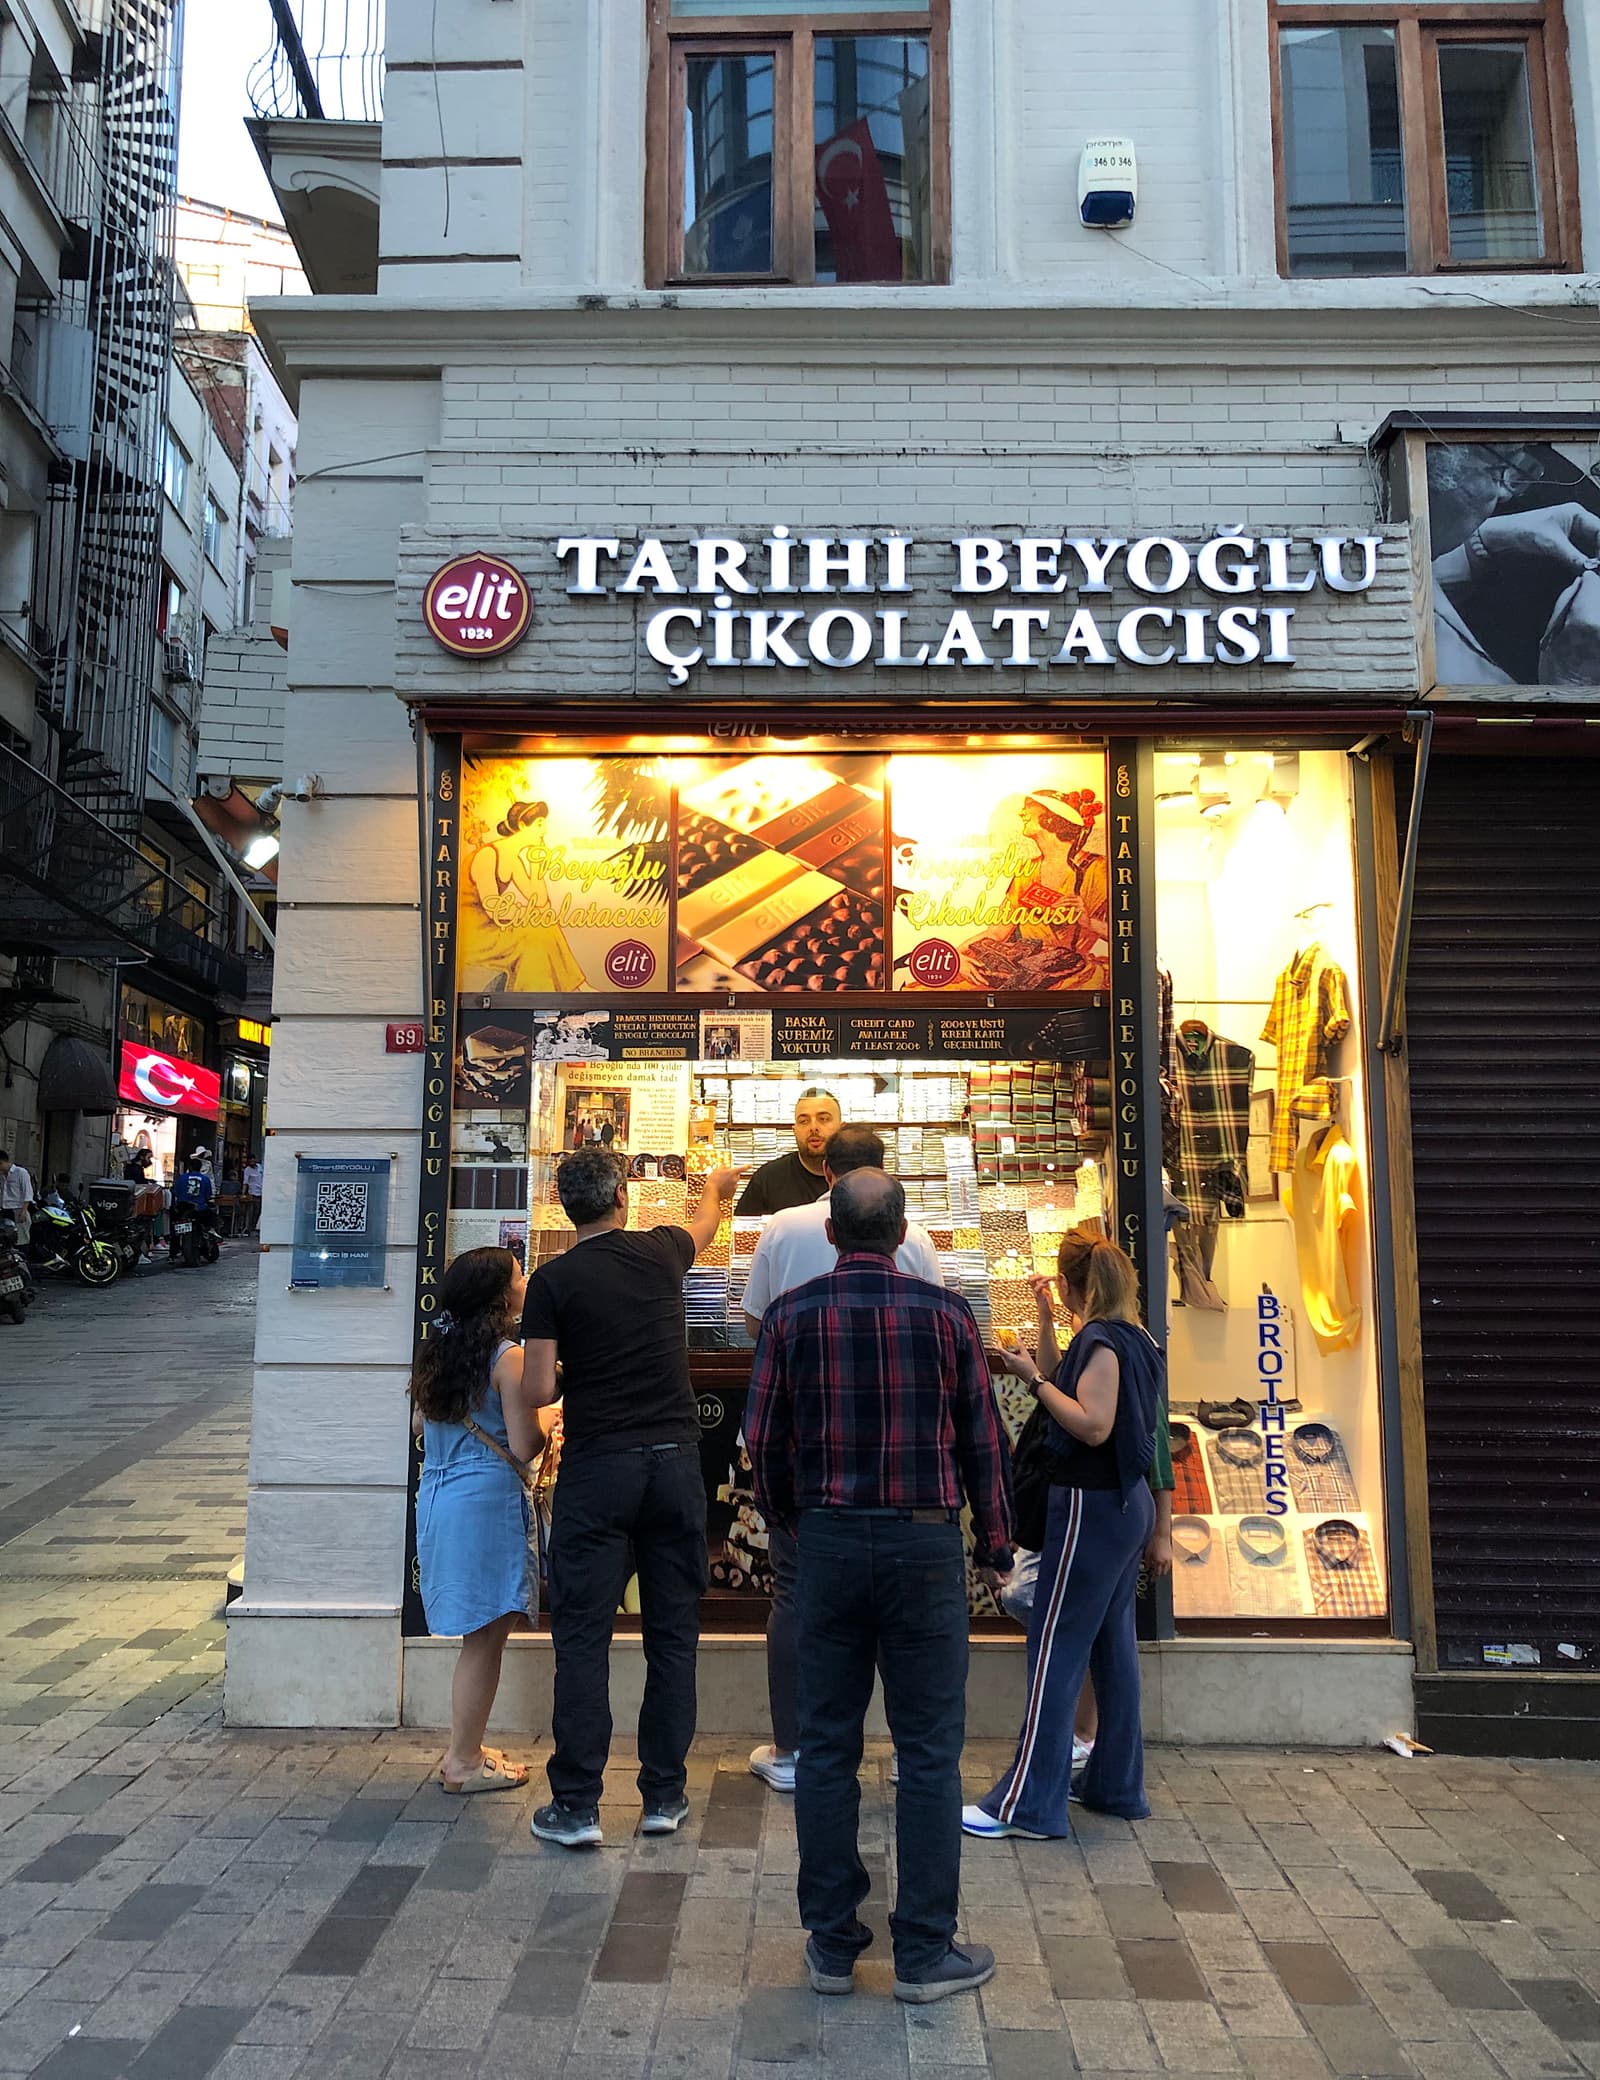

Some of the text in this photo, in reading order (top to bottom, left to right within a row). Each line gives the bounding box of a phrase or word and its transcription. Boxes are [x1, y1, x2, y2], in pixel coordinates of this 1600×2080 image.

[952, 523, 1383, 594] BEYOĞLU
[436, 571, 518, 620] elit
[460, 628, 493, 639] 1924
[646, 596, 1297, 687] ÇİKOLATACISI
[528, 845, 666, 893] Beyoğlu
[434, 819, 453, 965] TARİHİ
[1117, 816, 1134, 963] TARİHİ
[484, 892, 666, 932] Çikolatacısı
[896, 892, 1082, 930] Çikolatacısı
[612, 950, 649, 972] elit
[916, 948, 953, 971] elit
[615, 1014, 647, 1022] FAMOUS
[649, 1014, 696, 1022] HISTORICAL
[785, 1016, 827, 1028] BAŞKA
[850, 1019, 915, 1028] CREDIT CARD
[649, 1022, 697, 1030] PRODUCTION
[941, 1029, 1005, 1038] KREDİ KARTI
[395, 1030, 416, 1045] 69
[651, 1031, 697, 1039] CHOCOLATE
[777, 1028, 834, 1041] ŞUBEMİZ
[858, 1031, 908, 1039] AVAILABLE
[781, 1043, 832, 1053] YOKTUR
[850, 1042, 862, 1050] AT
[865, 1042, 894, 1050] LEAST
[568, 1071, 624, 1082] değişmeyen
[627, 1072, 656, 1081] damak
[426, 1000, 447, 1175] BEYOĞLU
[1120, 999, 1138, 1177] BEYOĞLU
[97, 1200, 118, 1211] vigo
[1257, 1295, 1288, 1516] BROTHERS
